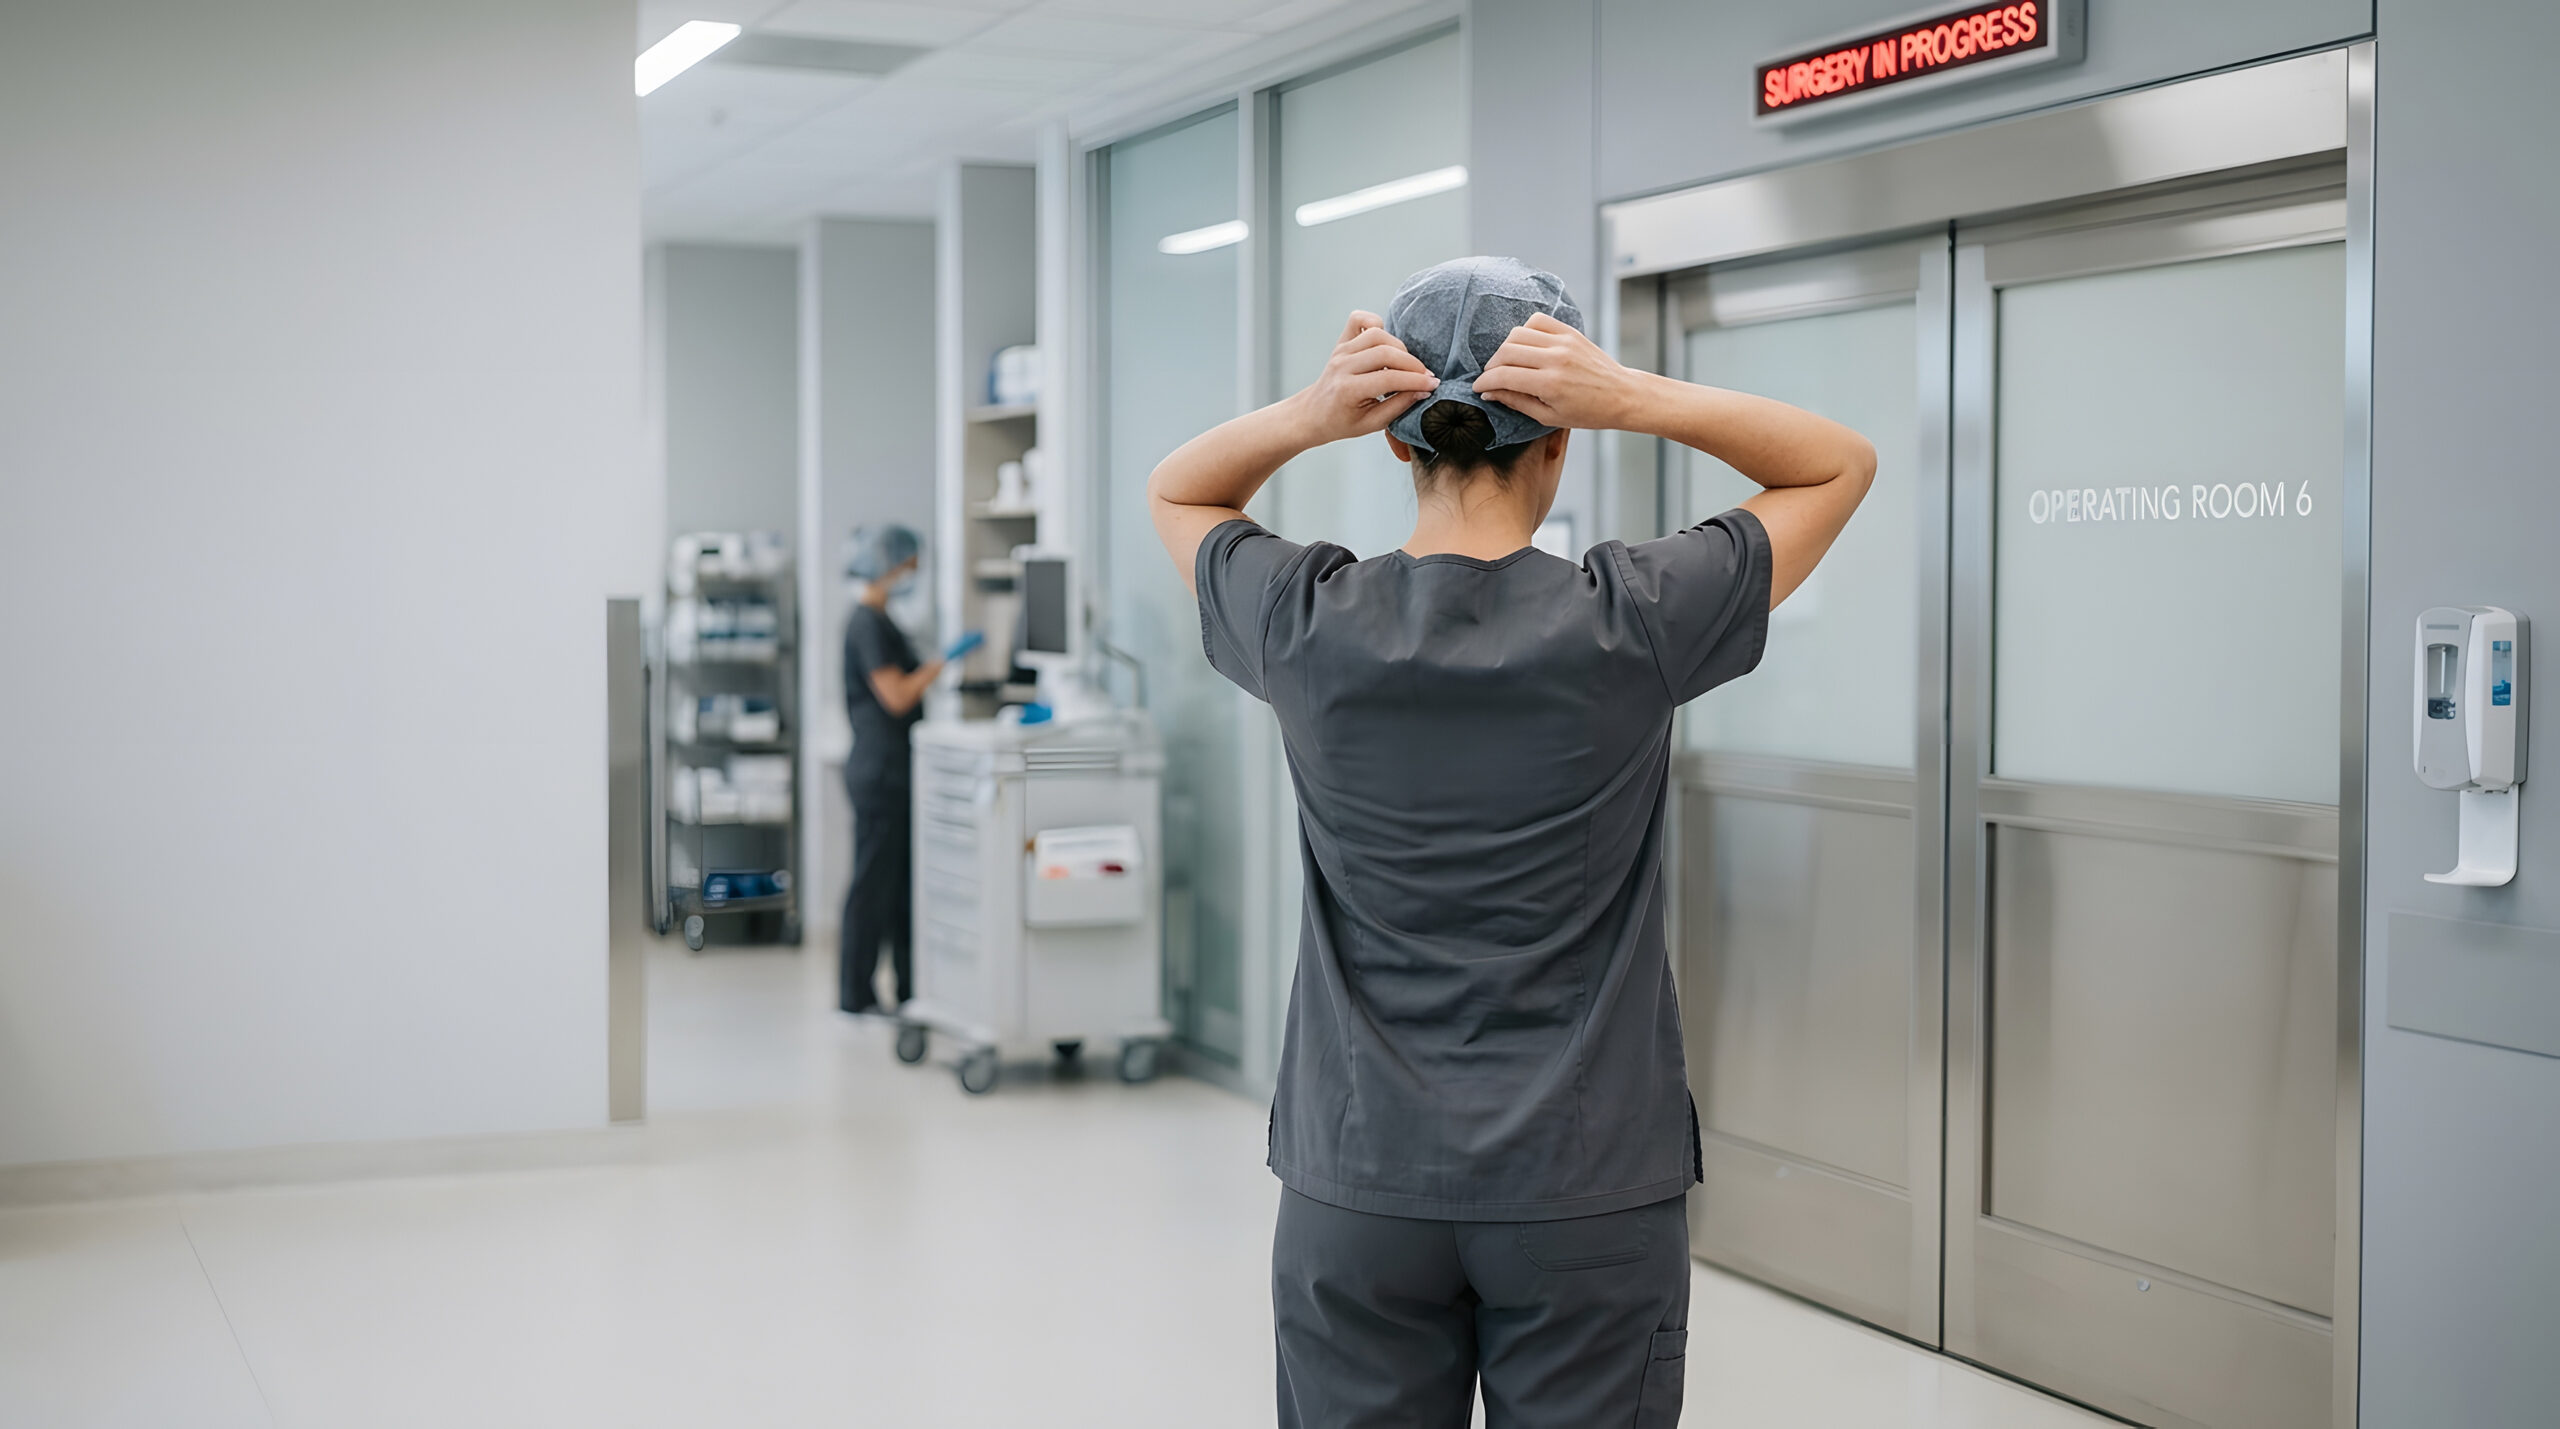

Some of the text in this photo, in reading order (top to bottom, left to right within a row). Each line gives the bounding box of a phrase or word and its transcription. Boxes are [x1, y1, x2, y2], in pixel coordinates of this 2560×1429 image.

[1764, 2, 2037, 108] SURGERY IN PROGRESS
[2029, 480, 2312, 524] OPERATING ROOM 6
